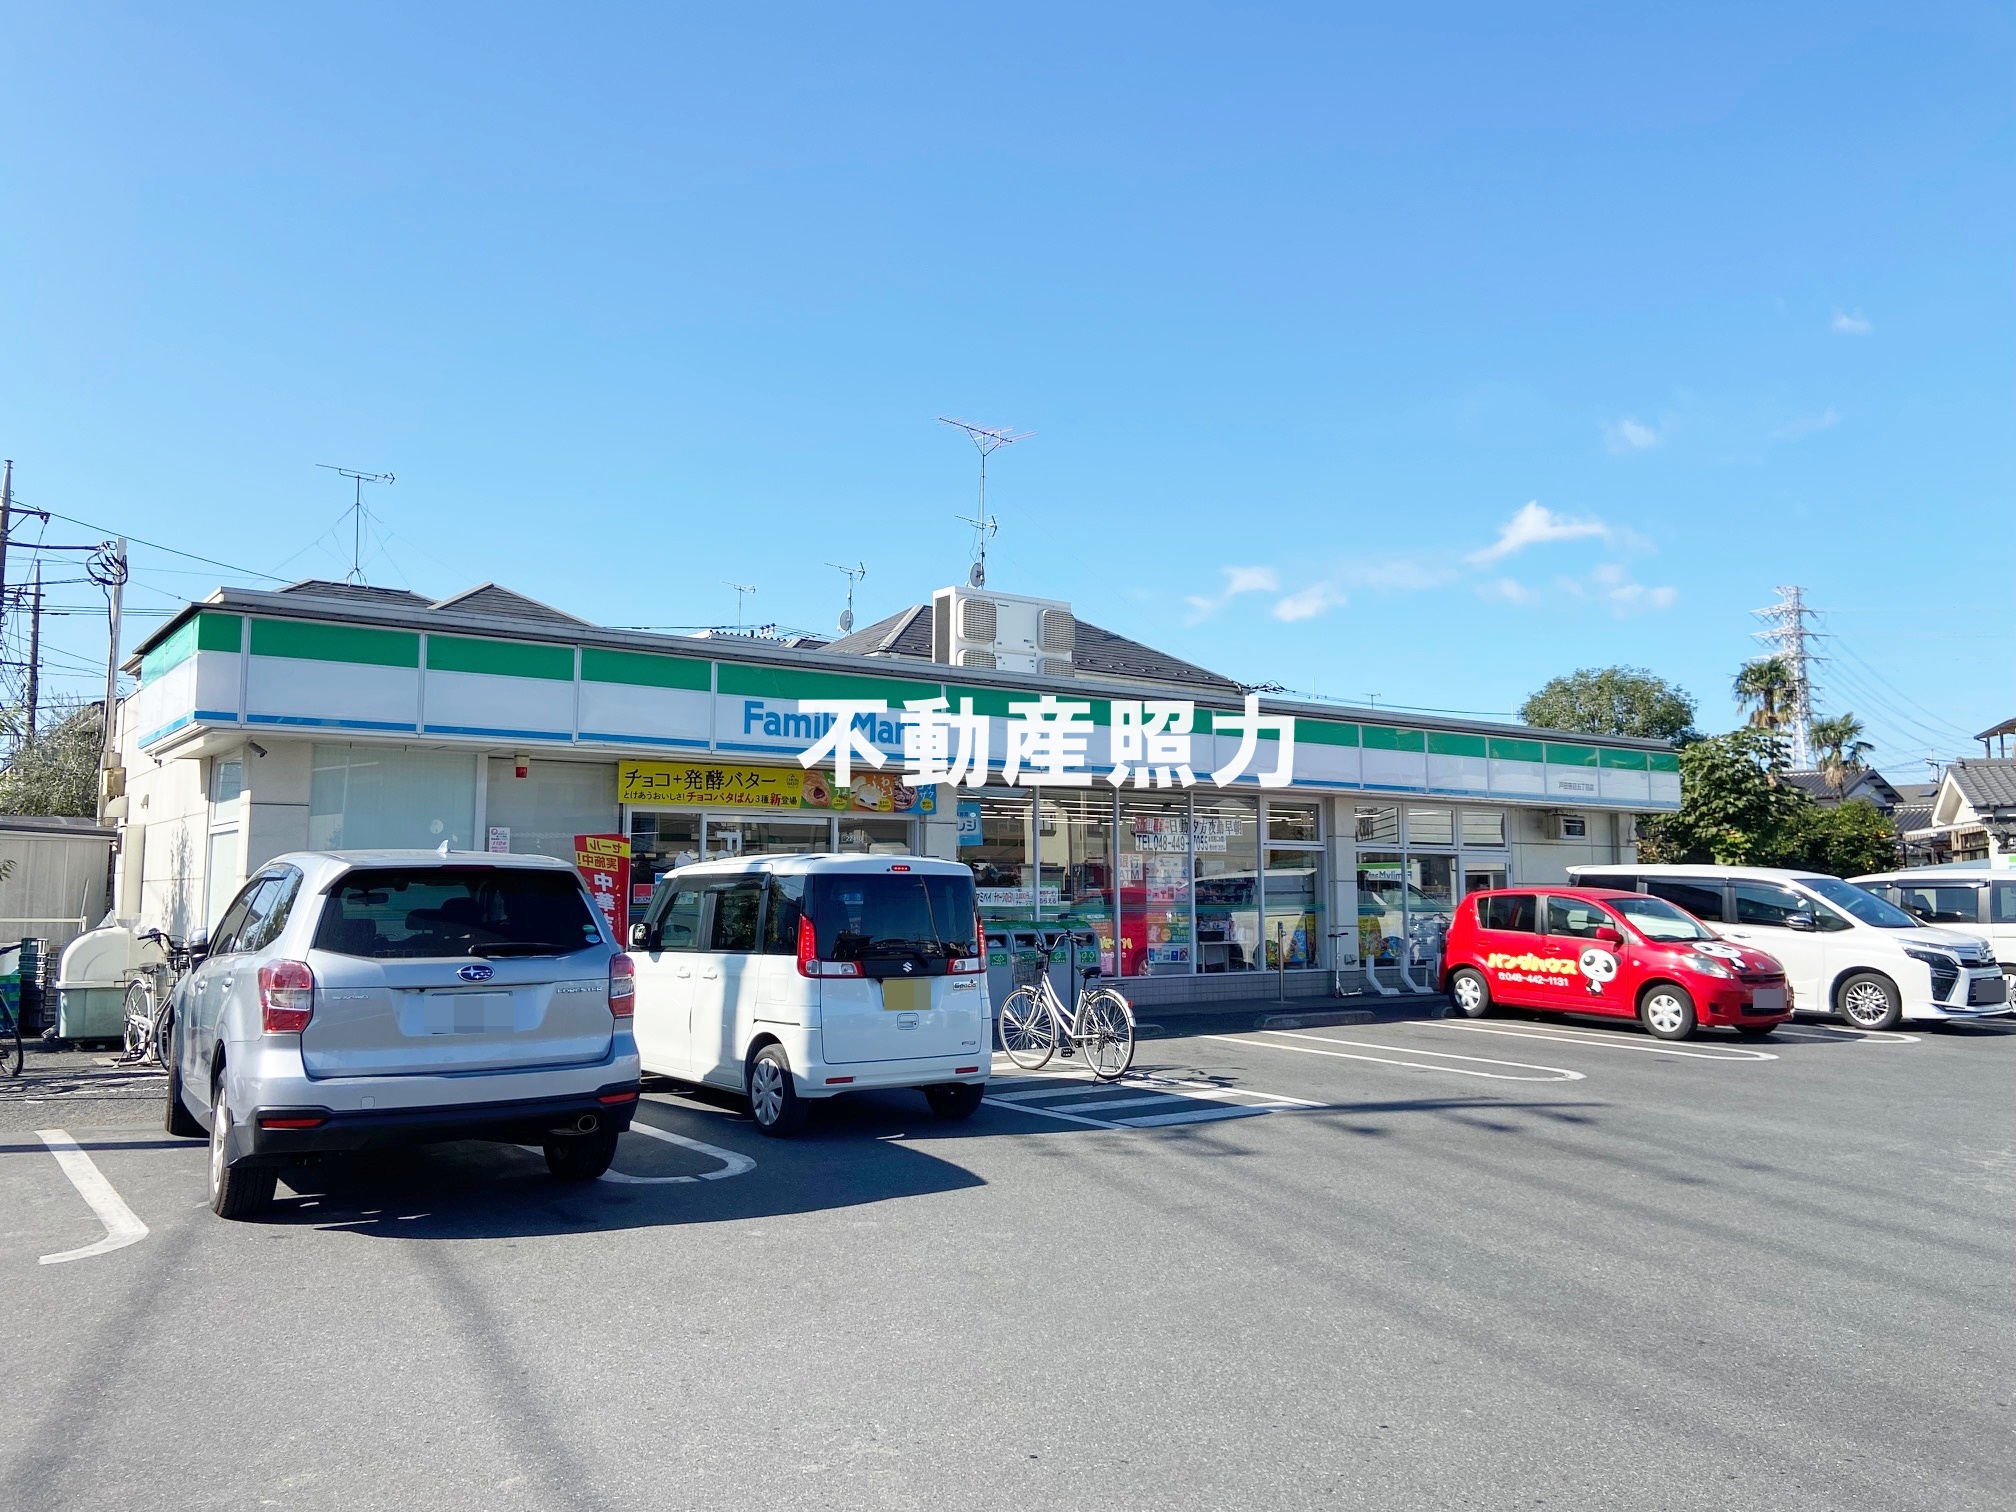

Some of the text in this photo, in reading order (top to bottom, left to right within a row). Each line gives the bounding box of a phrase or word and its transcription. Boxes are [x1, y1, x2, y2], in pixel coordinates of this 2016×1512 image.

[625, 768, 777, 791] チョコ+発酵バター
[1119, 869, 1140, 879] ATM
[1487, 952, 1578, 975] パンダハウス
[557, 986, 603, 994] FORESTER
